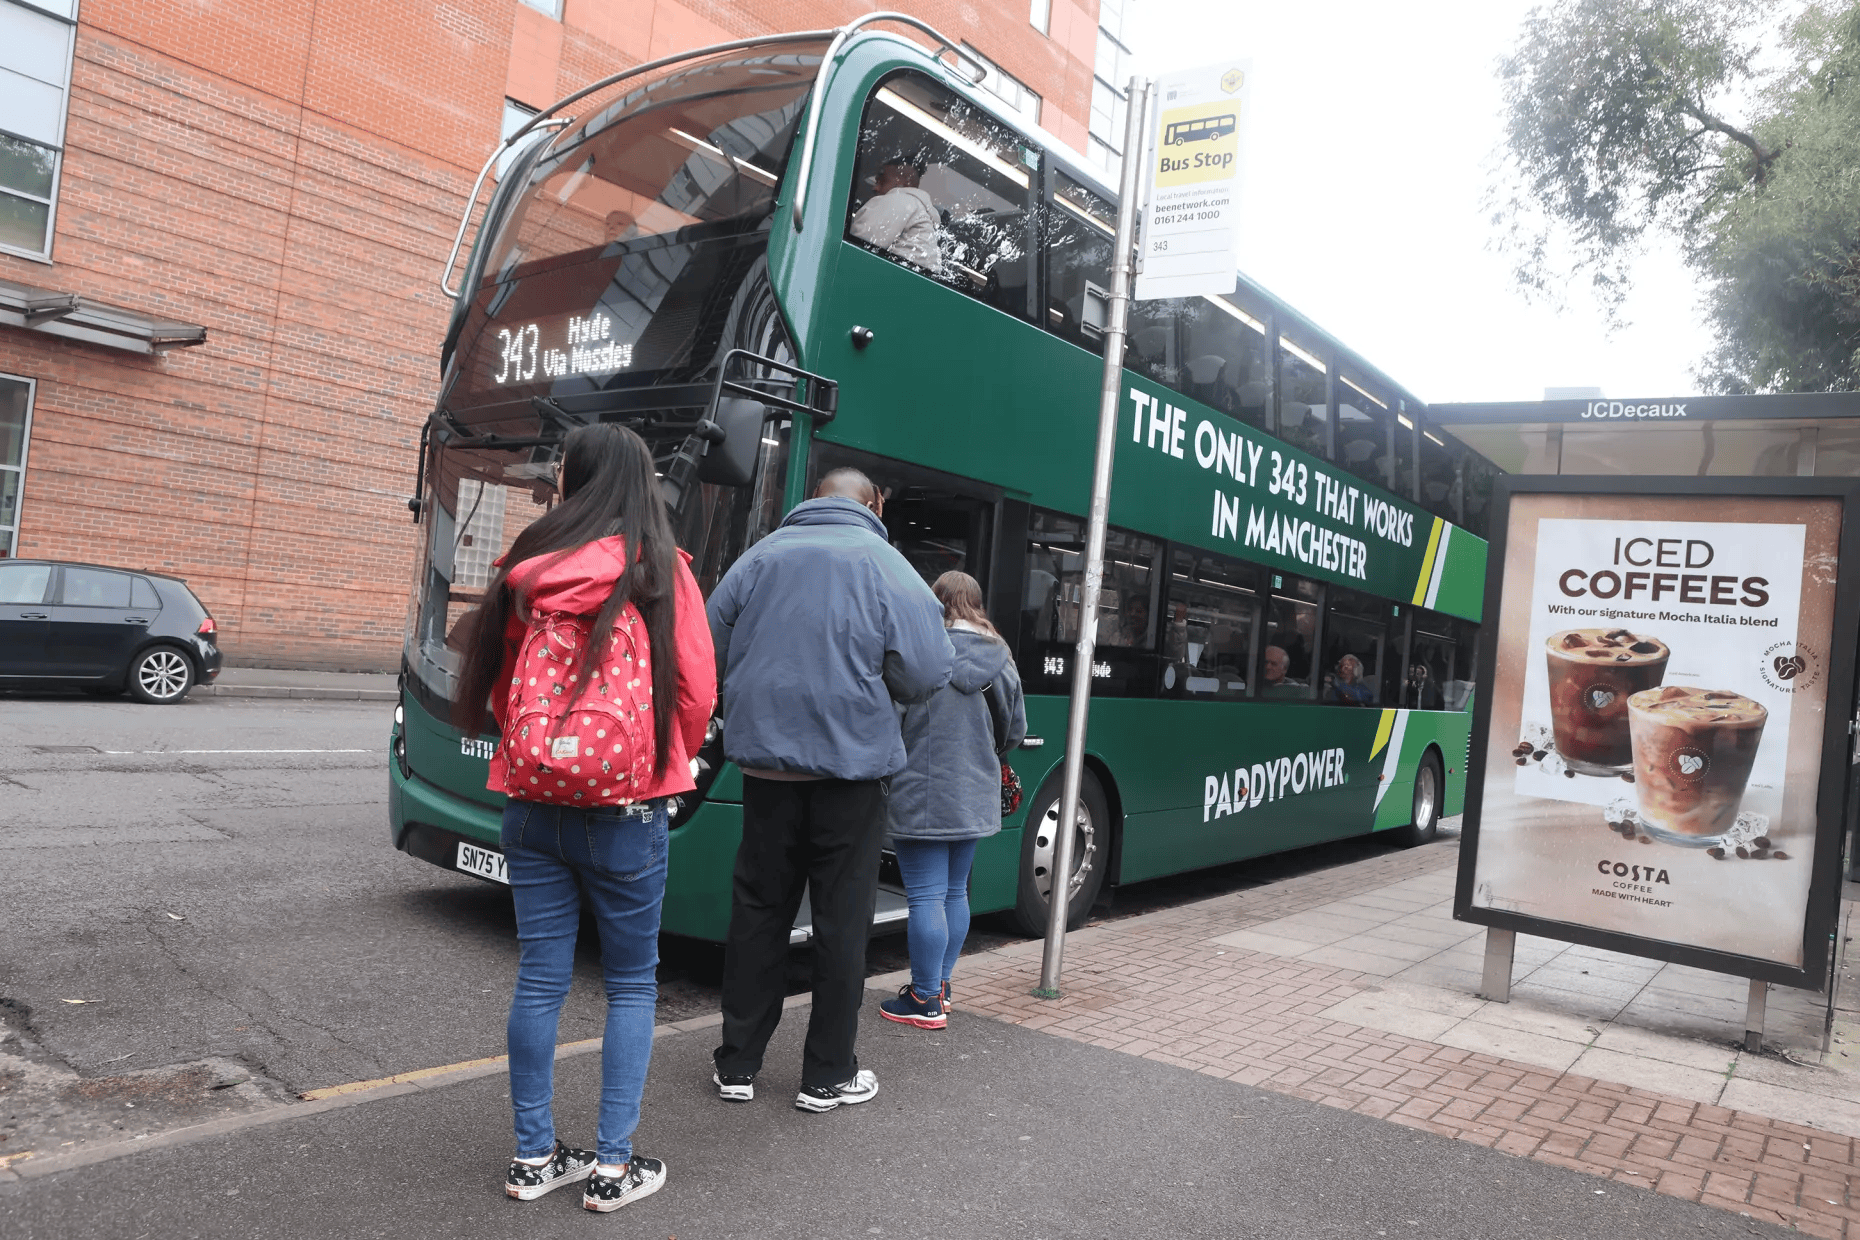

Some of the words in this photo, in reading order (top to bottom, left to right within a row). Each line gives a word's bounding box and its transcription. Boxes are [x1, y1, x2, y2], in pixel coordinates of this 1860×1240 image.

[1160, 156, 1189, 173] Bus
[1193, 151, 1233, 169] Stop
[1155, 198, 1230, 213] beenetwork.com
[1174, 190, 1191, 199] travel
[1154, 215, 1175, 225] 0161
[1177, 212, 1194, 223] 244
[1197, 210, 1220, 221] 1000
[1153, 240, 1168, 252] 343
[567, 312, 611, 345] Hyde
[494, 323, 540, 384] 343
[543, 348, 567, 377] Via
[571, 340, 633, 374] Mossley
[1581, 402, 1687, 419] JCDecaux
[1129, 387, 1187, 460] THE
[1194, 419, 1264, 487] ONLY
[1268, 450, 1308, 505] 343
[1314, 470, 1359, 526] THAT
[1363, 493, 1414, 548] WORKS
[1211, 489, 1240, 542] IN
[1244, 503, 1367, 580] MANCHESTER
[1613, 537, 1715, 570] ICED
[1558, 568, 1770, 608] COFFEES
[1548, 604, 1576, 615] With
[1578, 608, 1598, 616] our
[1599, 608, 1656, 620] signature
[1658, 611, 1701, 623] Mocha
[1703, 613, 1737, 625] Italia
[1739, 616, 1778, 627] blend
[1763, 641, 1792, 656] MOCHA
[1796, 641, 1818, 660] ITALIA
[1760, 667, 1797, 693] SIGNATURE
[1801, 671, 1820, 690] TASTE
[462, 846, 494, 874] SN75
[1597, 859, 1670, 885] COSTA
[1592, 888, 1617, 898] MADE
[1618, 893, 1641, 903] WITH
[1642, 897, 1672, 908] HEART
[1612, 881, 1653, 893] COFFEE
